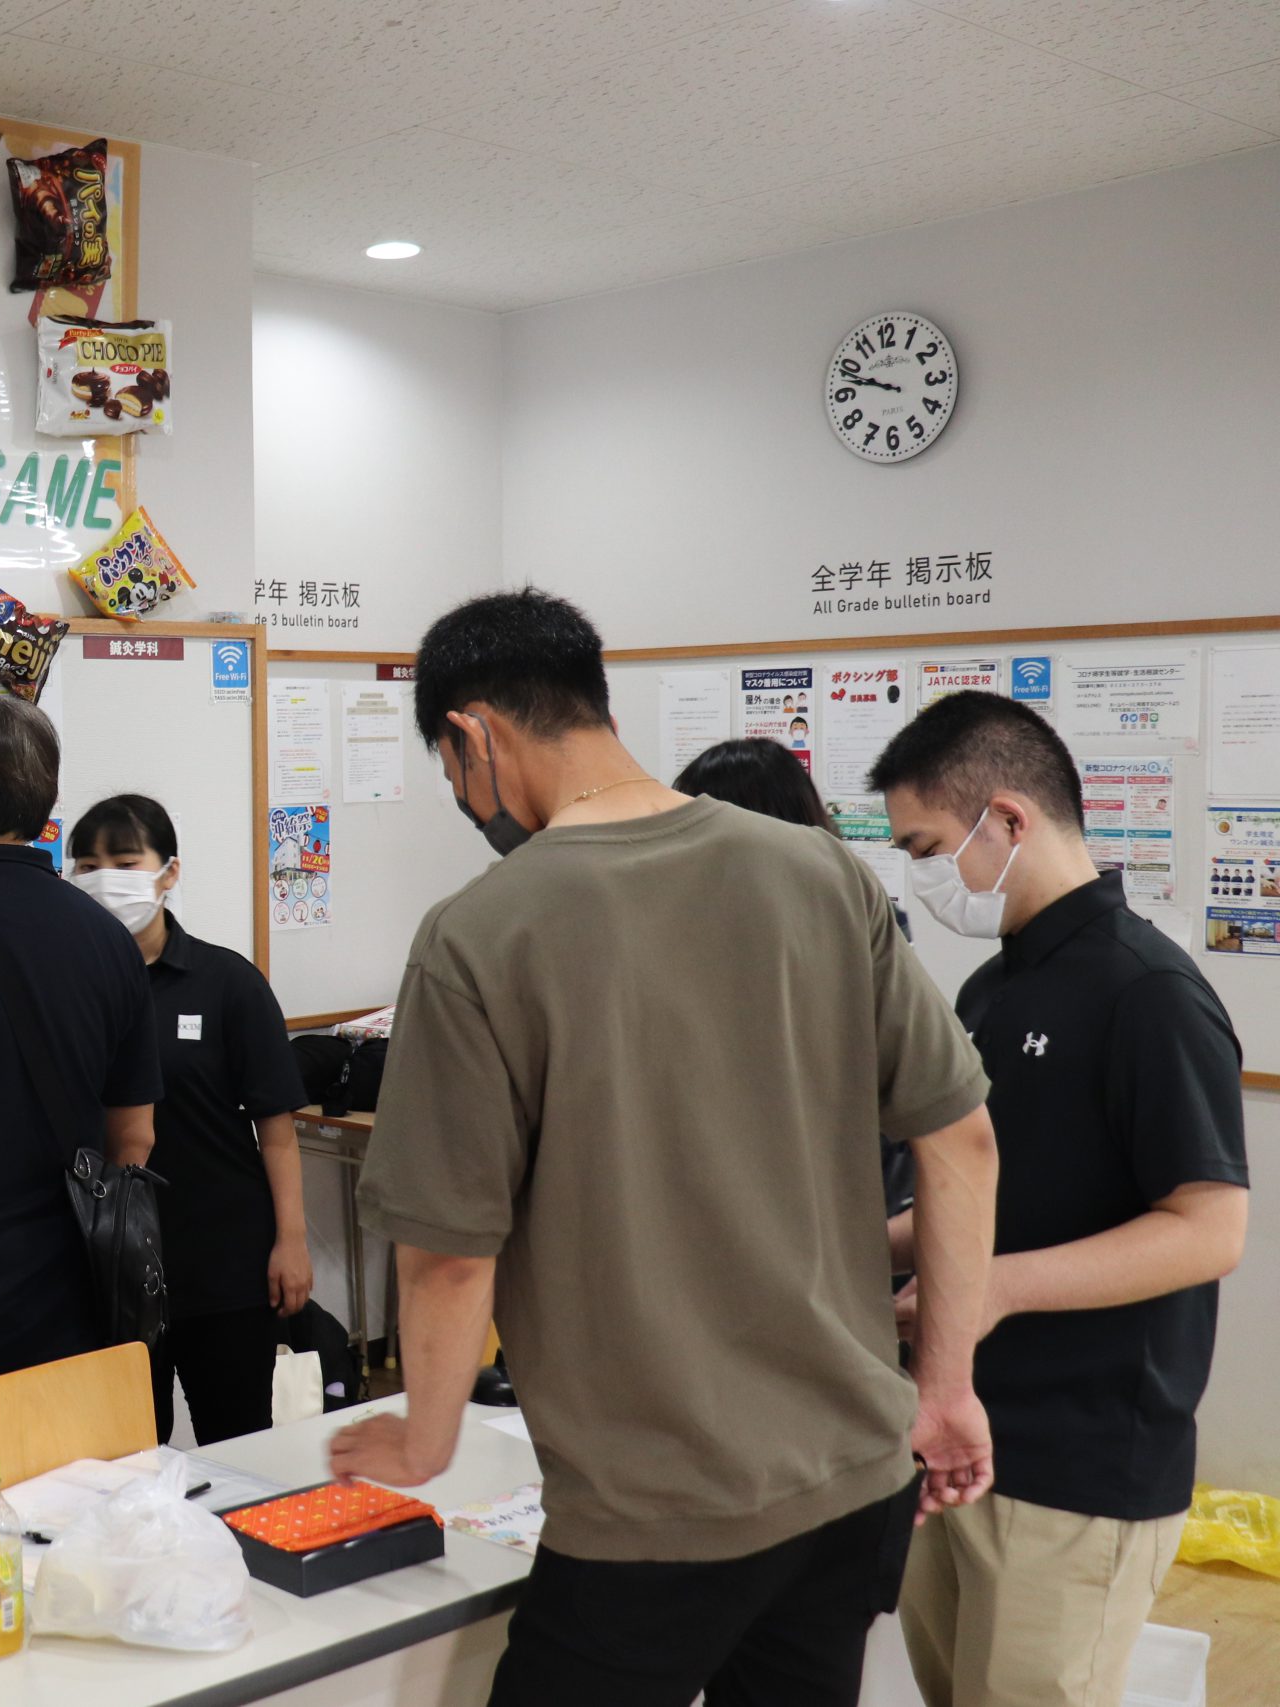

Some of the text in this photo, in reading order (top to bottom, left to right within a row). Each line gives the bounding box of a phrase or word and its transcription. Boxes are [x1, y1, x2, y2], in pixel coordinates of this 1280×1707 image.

[74, 168, 104, 269] パイの実
[877, 322, 896, 349] 12
[904, 326, 917, 350] 1
[81, 341, 164, 363] CHOCO PIE
[855, 334, 876, 360] 11
[915, 342, 939, 366] 2
[113, 365, 138, 374] チョコパイ
[838, 358, 861, 378] 10
[924, 370, 948, 387] 3
[834, 387, 856, 403] 9
[922, 396, 942, 415] 4
[843, 408, 863, 430] 8
[905, 415, 924, 439] 5
[863, 422, 880, 446] 7
[886, 425, 900, 450] 6
[811, 551, 993, 593] 全学年 掲示板
[299, 580, 361, 608] 掲示板
[813, 589, 991, 614] All Grade bulletin board
[271, 614, 278, 626] 3
[281, 614, 324, 628] bulletin
[328, 616, 359, 629] board
[109, 640, 159, 656] 鍼灸学科
[215, 672, 247, 680] Free Wi-Fi
[745, 677, 809, 688] マスク着用について
[831, 669, 898, 684] ボクシング部
[927, 675, 992, 686] JATAC認定校
[1013, 685, 1049, 693] Free Wi-Fi
[1085, 764, 1147, 772] 新型コロナウイルス
